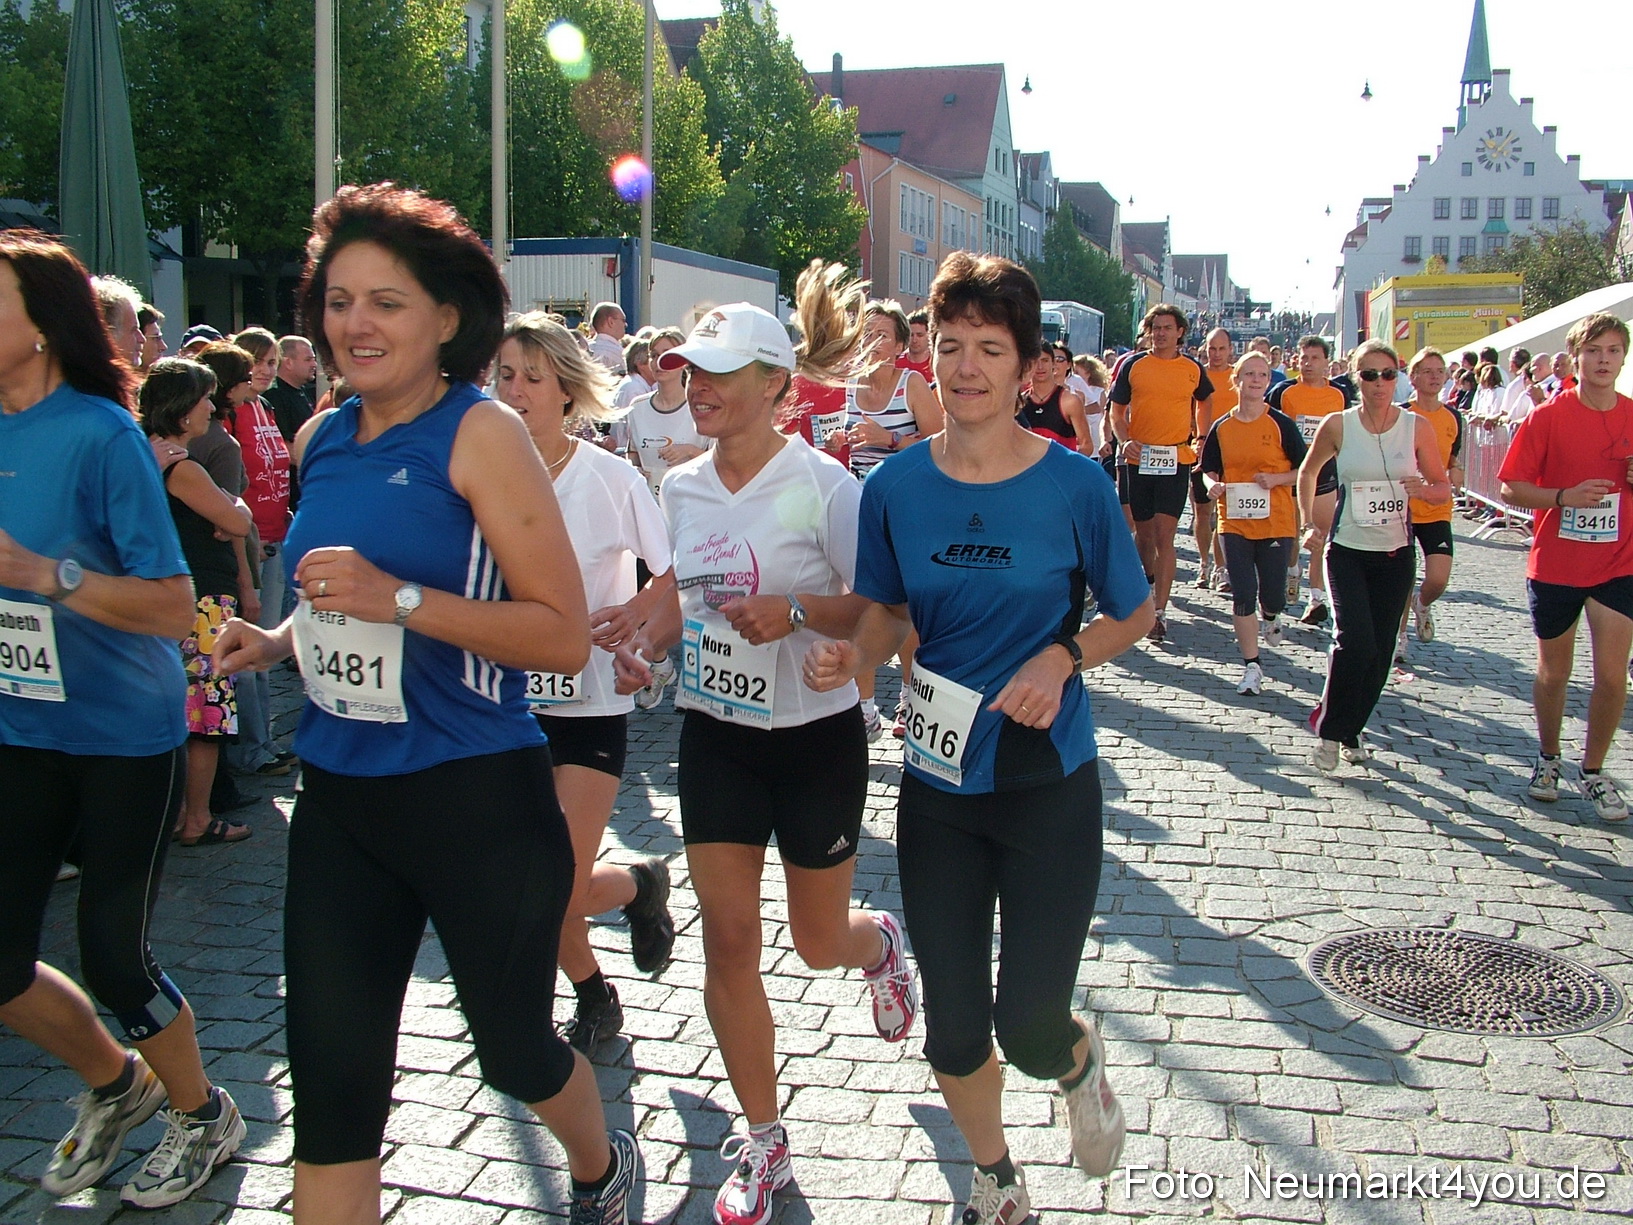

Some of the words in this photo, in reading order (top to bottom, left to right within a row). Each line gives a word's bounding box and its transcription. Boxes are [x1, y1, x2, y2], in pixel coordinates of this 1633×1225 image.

[819, 416, 840, 424] Markus
[1150, 457, 1175, 468] 2793
[1238, 498, 1266, 509] 3592
[1369, 500, 1404, 514] 3498
[1564, 509, 1572, 518] D
[1577, 515, 1616, 529] 3416
[945, 544, 1012, 560] ERTEL
[944, 556, 1011, 566] AUTOMOBILE
[702, 634, 731, 657] Nora
[313, 643, 383, 689] 3481
[687, 652, 695, 666] C
[526, 673, 574, 698] 315
[703, 664, 767, 703] 2592
